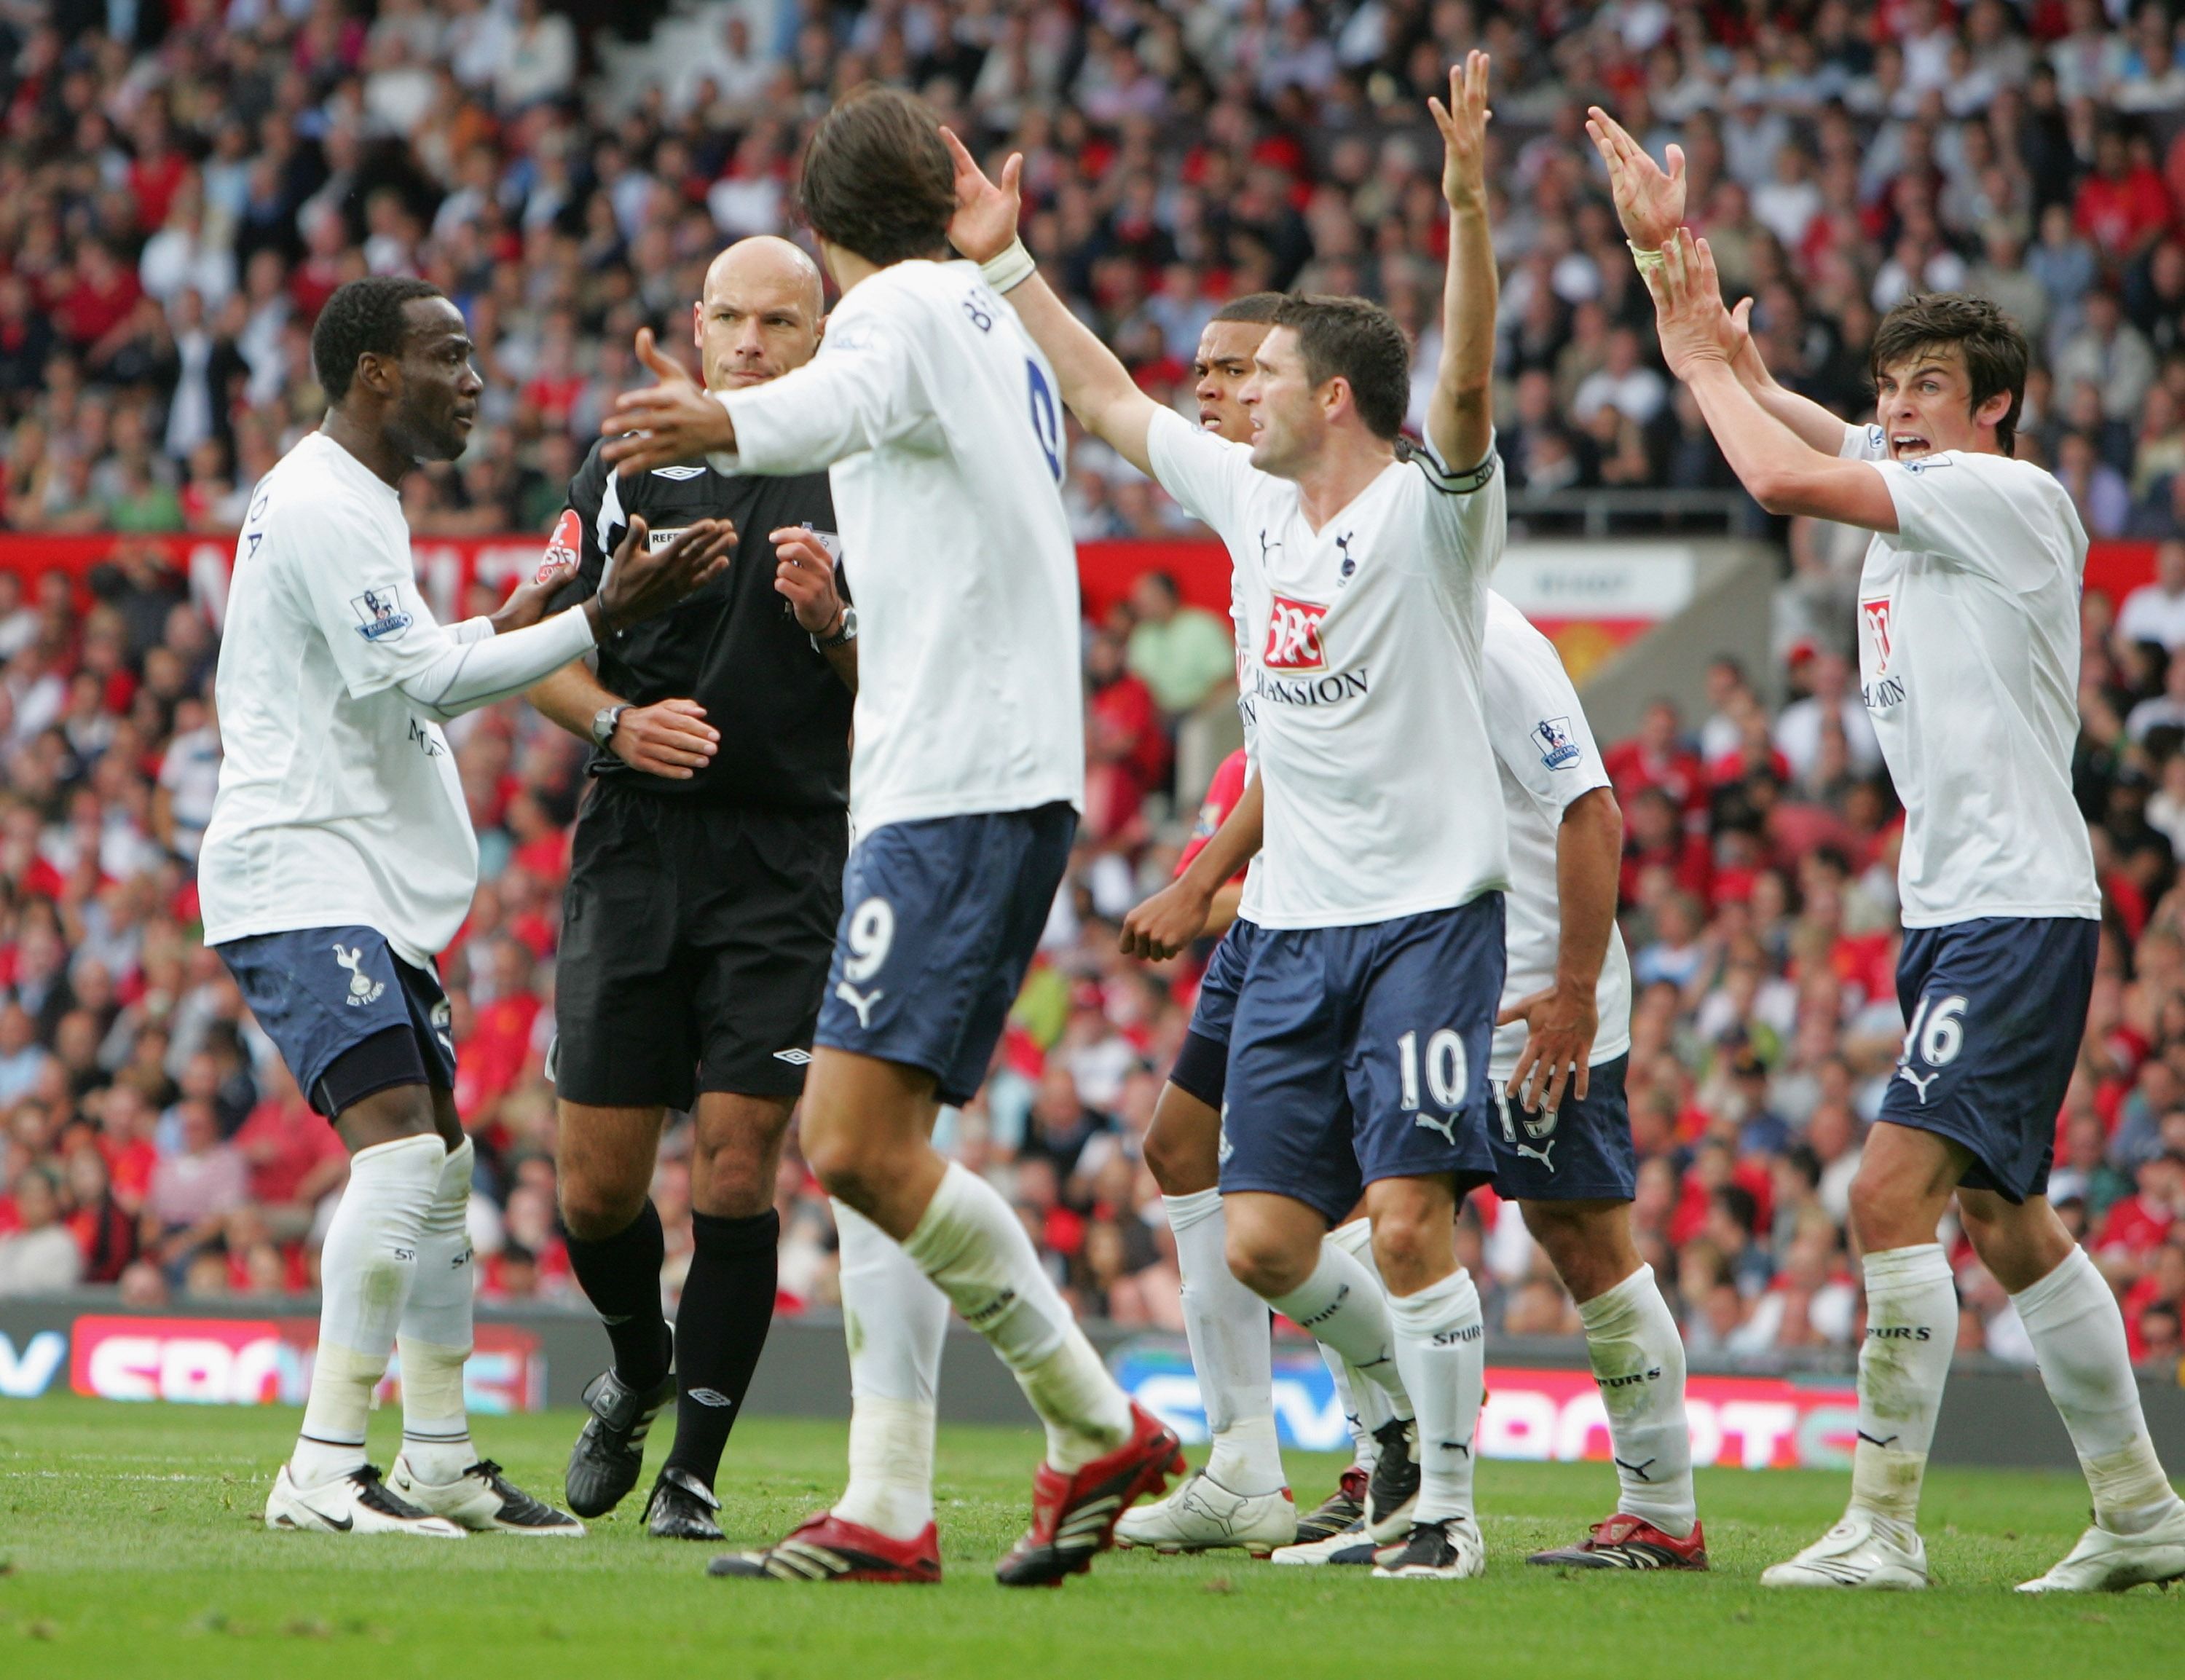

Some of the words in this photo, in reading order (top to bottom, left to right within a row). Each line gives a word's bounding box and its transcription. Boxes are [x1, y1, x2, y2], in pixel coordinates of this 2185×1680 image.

[843, 896, 896, 983] 9
[1896, 995, 1969, 1067] 16
[1397, 1028, 1468, 1111] 10
[1433, 1324, 1484, 1347] SPUR
[1594, 1366, 1660, 1388] PURS
